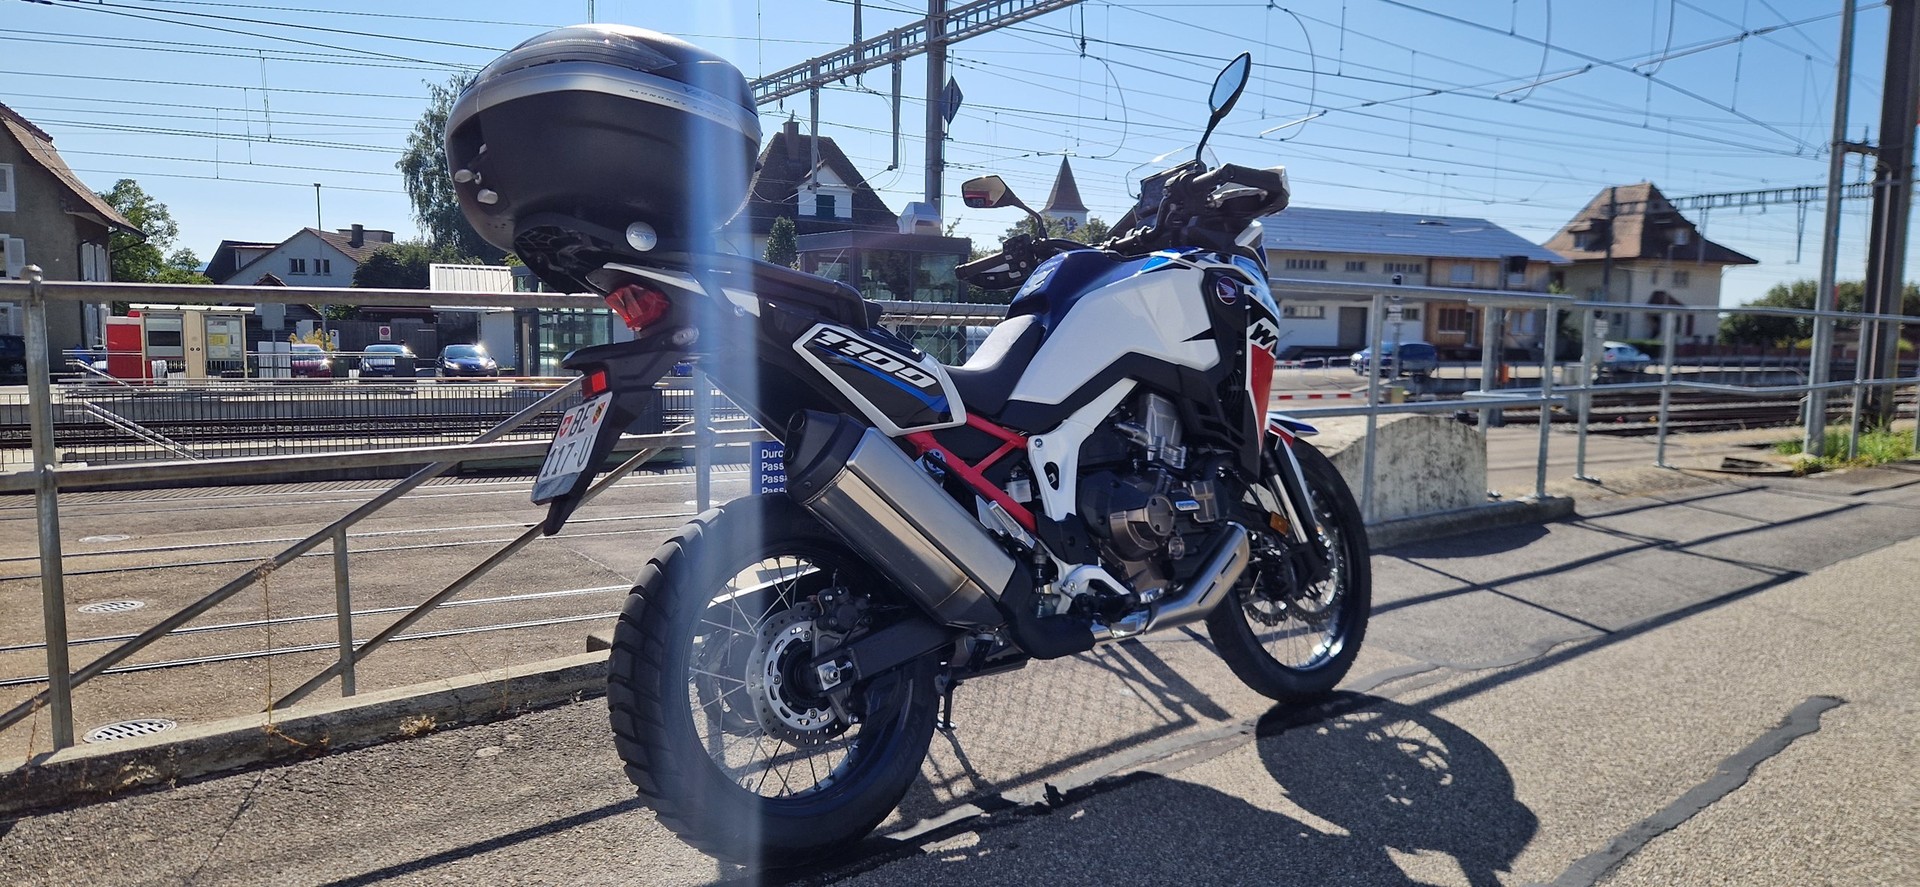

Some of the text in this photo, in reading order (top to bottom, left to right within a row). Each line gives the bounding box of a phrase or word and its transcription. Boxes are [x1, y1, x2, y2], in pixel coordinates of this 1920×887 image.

[814, 330, 937, 388] 1100
[568, 402, 595, 436] BE
[761, 486, 787, 494] Pass
